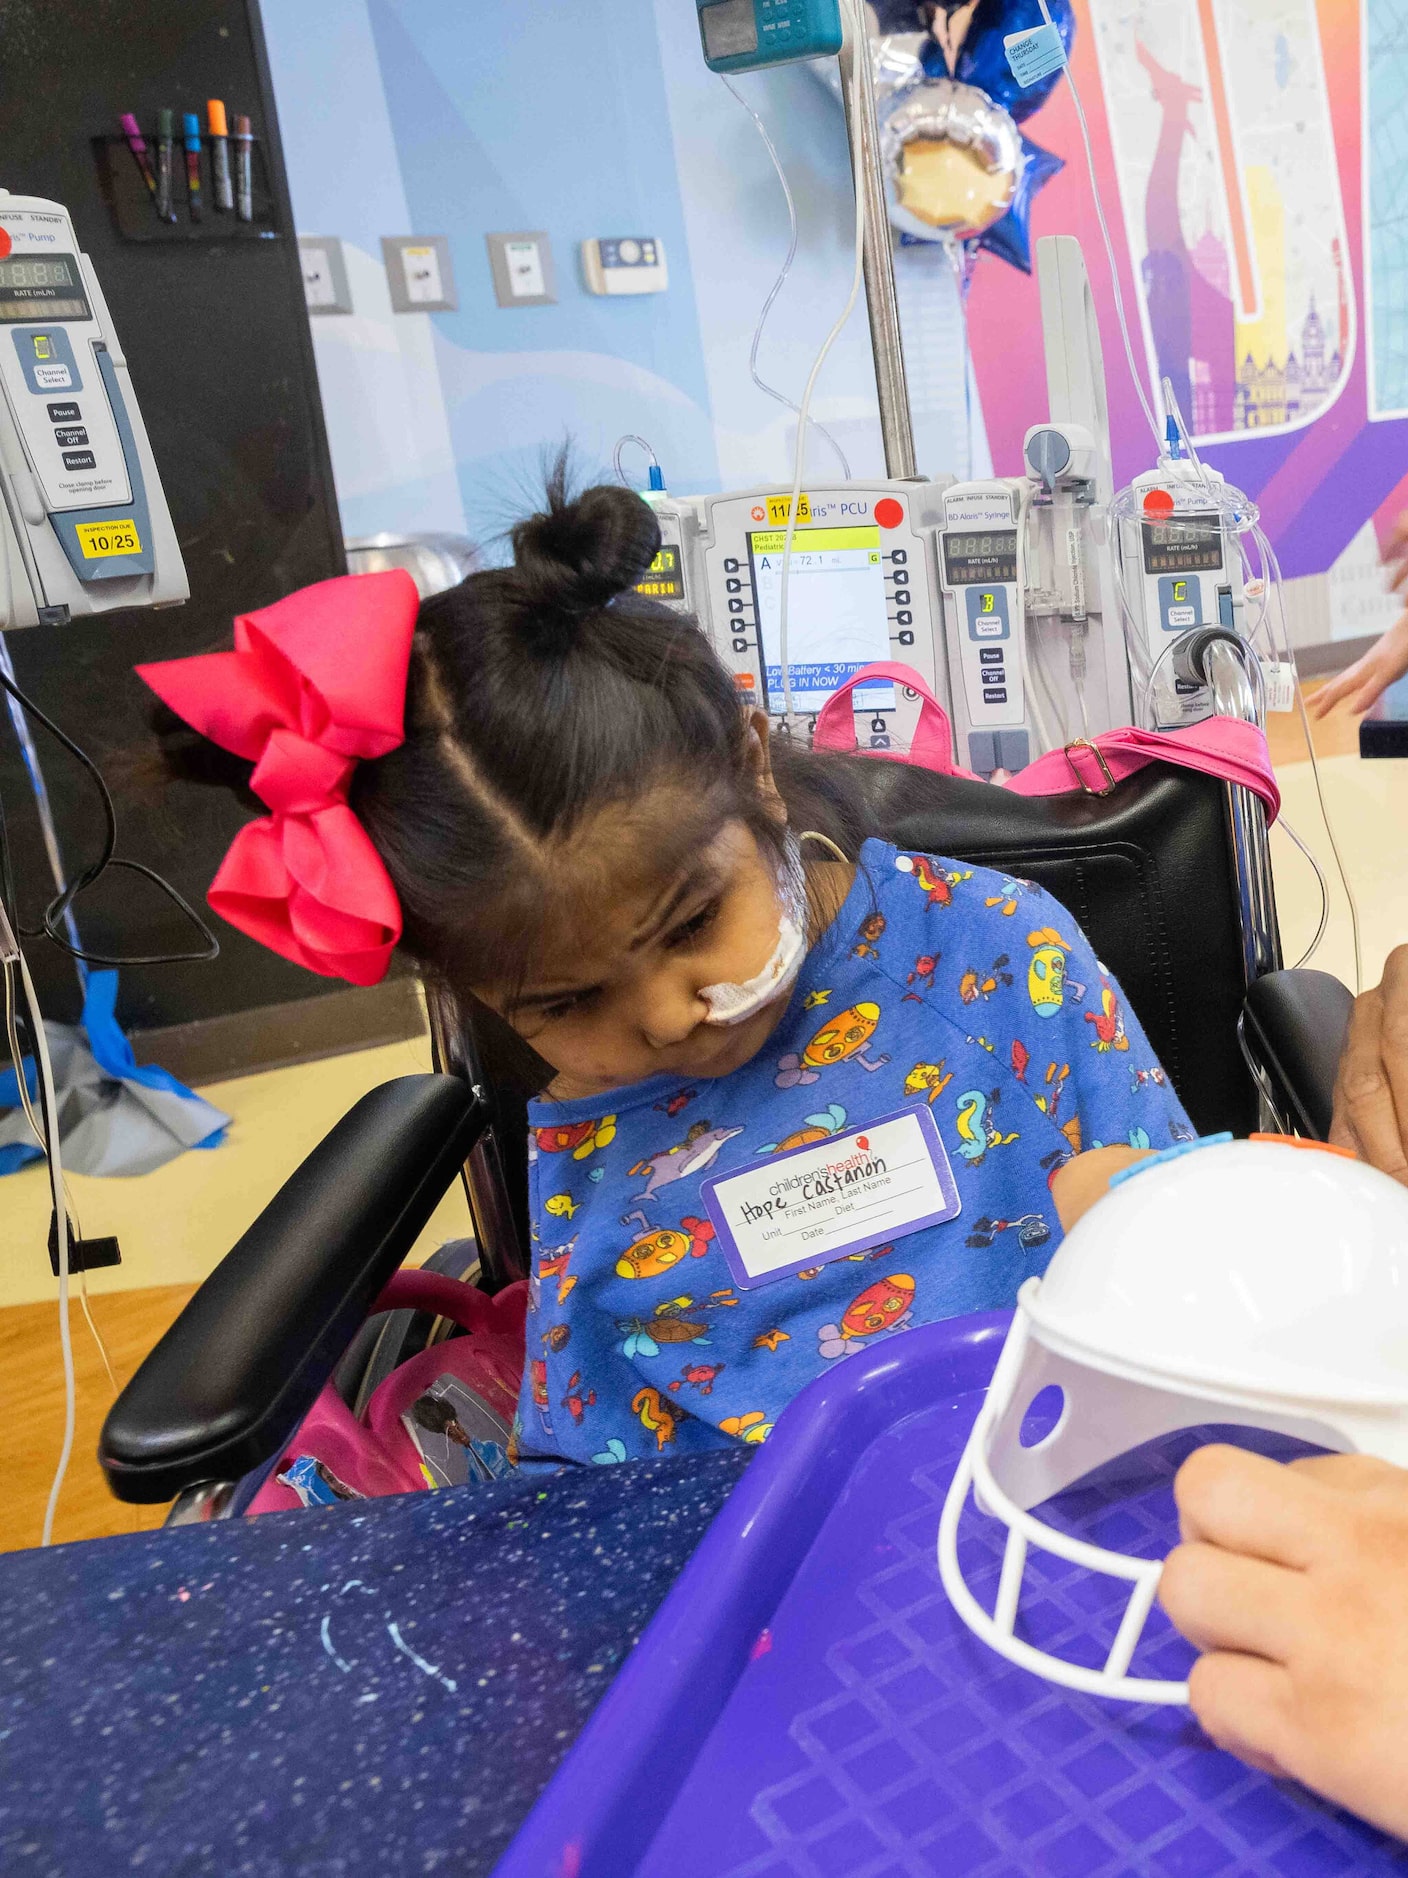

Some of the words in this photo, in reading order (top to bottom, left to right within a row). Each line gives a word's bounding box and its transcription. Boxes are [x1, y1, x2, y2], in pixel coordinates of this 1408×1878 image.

[1009, 38, 1033, 55] CHANGE
[1011, 43, 1040, 61] THURSDAY
[30, 215, 62, 224] STANDBY
[28, 233, 56, 243] Pump
[13, 289, 32, 297] RATE
[37, 368, 67, 377] Channel
[53, 408, 76, 417] Pause
[56, 428, 86, 438] Channel
[67, 437, 79, 445] Off
[65, 455, 93, 465] Restart
[946, 496, 964, 504] ALARM
[1187, 498, 1208, 506] Pump
[840, 502, 868, 515] PCU
[948, 512, 959, 521] BD
[984, 511, 1010, 520] Syringe
[83, 525, 119, 533] INSPECTION
[89, 534, 135, 551] 10/25
[753, 534, 773, 542] CHST
[760, 557, 771, 570] A
[871, 554, 878, 562] G
[634, 582, 675, 595] PARIN
[1174, 581, 1187, 601] C
[977, 619, 1000, 627] Channel
[983, 652, 1000, 660] Pause
[788, 664, 821, 677] Battery
[833, 663, 846, 674] 30
[799, 677, 810, 687] IN
[812, 676, 840, 687] NOW
[784, 1204, 807, 1220] First
[808, 1196, 840, 1211] Name,
[840, 1186, 861, 1200] Last
[863, 1176, 892, 1192] Name
[740, 1196, 787, 1225] Hope
[761, 1228, 783, 1242] Unit
[834, 1203, 855, 1216] Diet
[801, 1227, 825, 1241] Date
